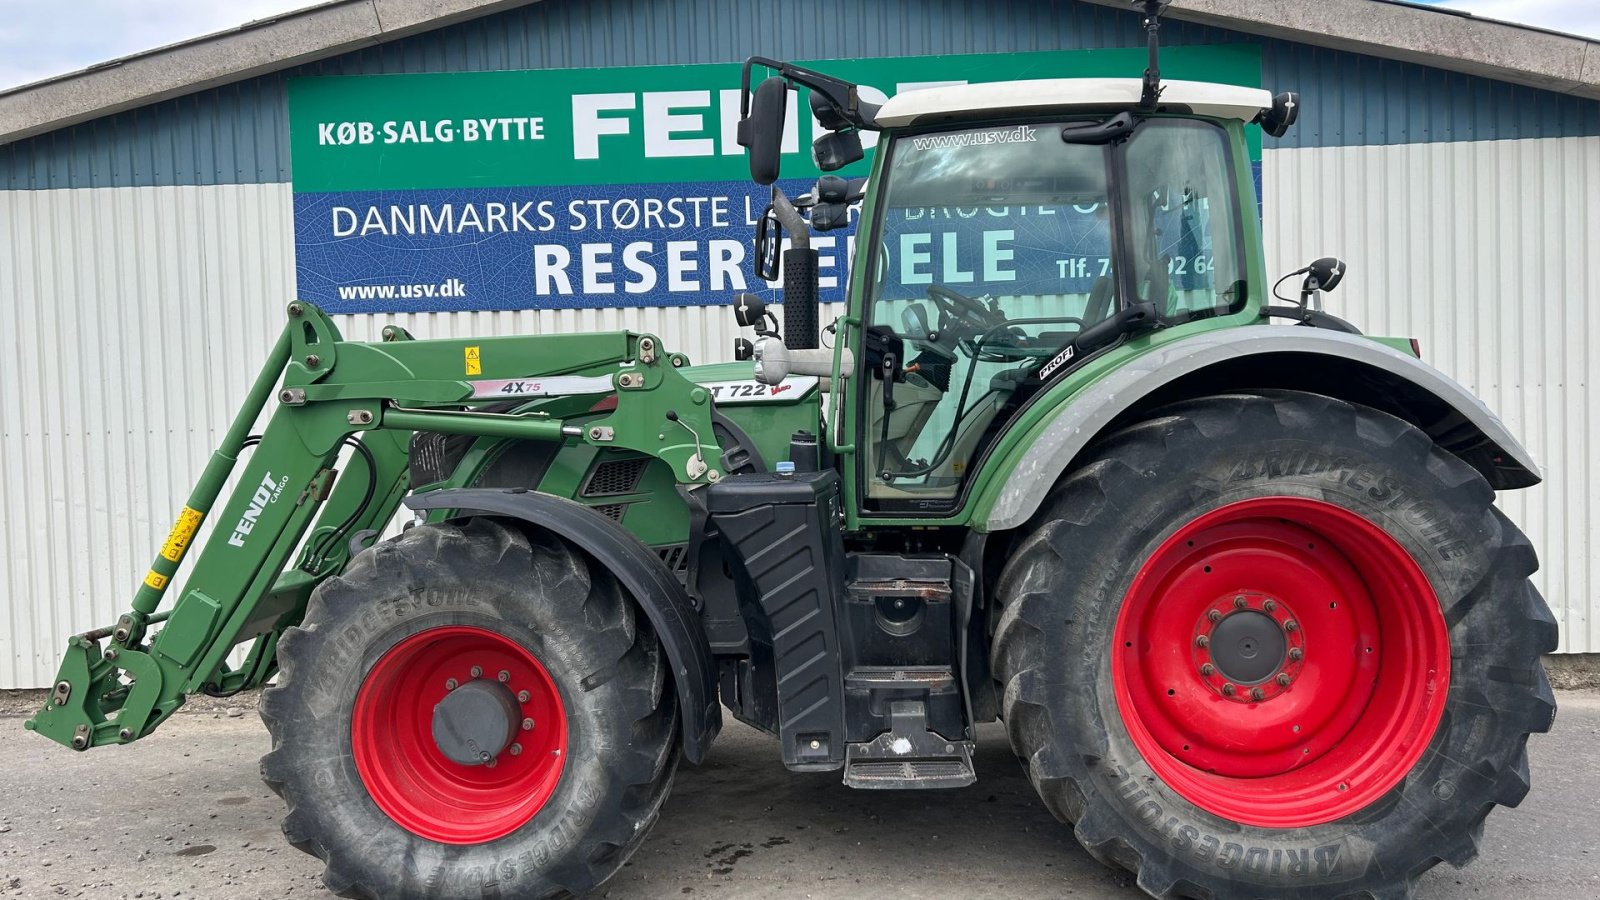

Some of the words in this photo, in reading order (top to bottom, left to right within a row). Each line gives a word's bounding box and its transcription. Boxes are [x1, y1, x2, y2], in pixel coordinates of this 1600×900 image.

[913, 126, 1037, 151] www.usv.dk
[332, 200, 555, 237] DANMARKS
[569, 195, 730, 232] STØRSTE
[1056, 258, 1092, 279] Tlf.
[338, 278, 466, 300] www.usv.dk
[1040, 346, 1073, 377] PROFI
[730, 384, 767, 397] 722
[269, 475, 289, 504] CARGO
[227, 471, 277, 548] FENDT
